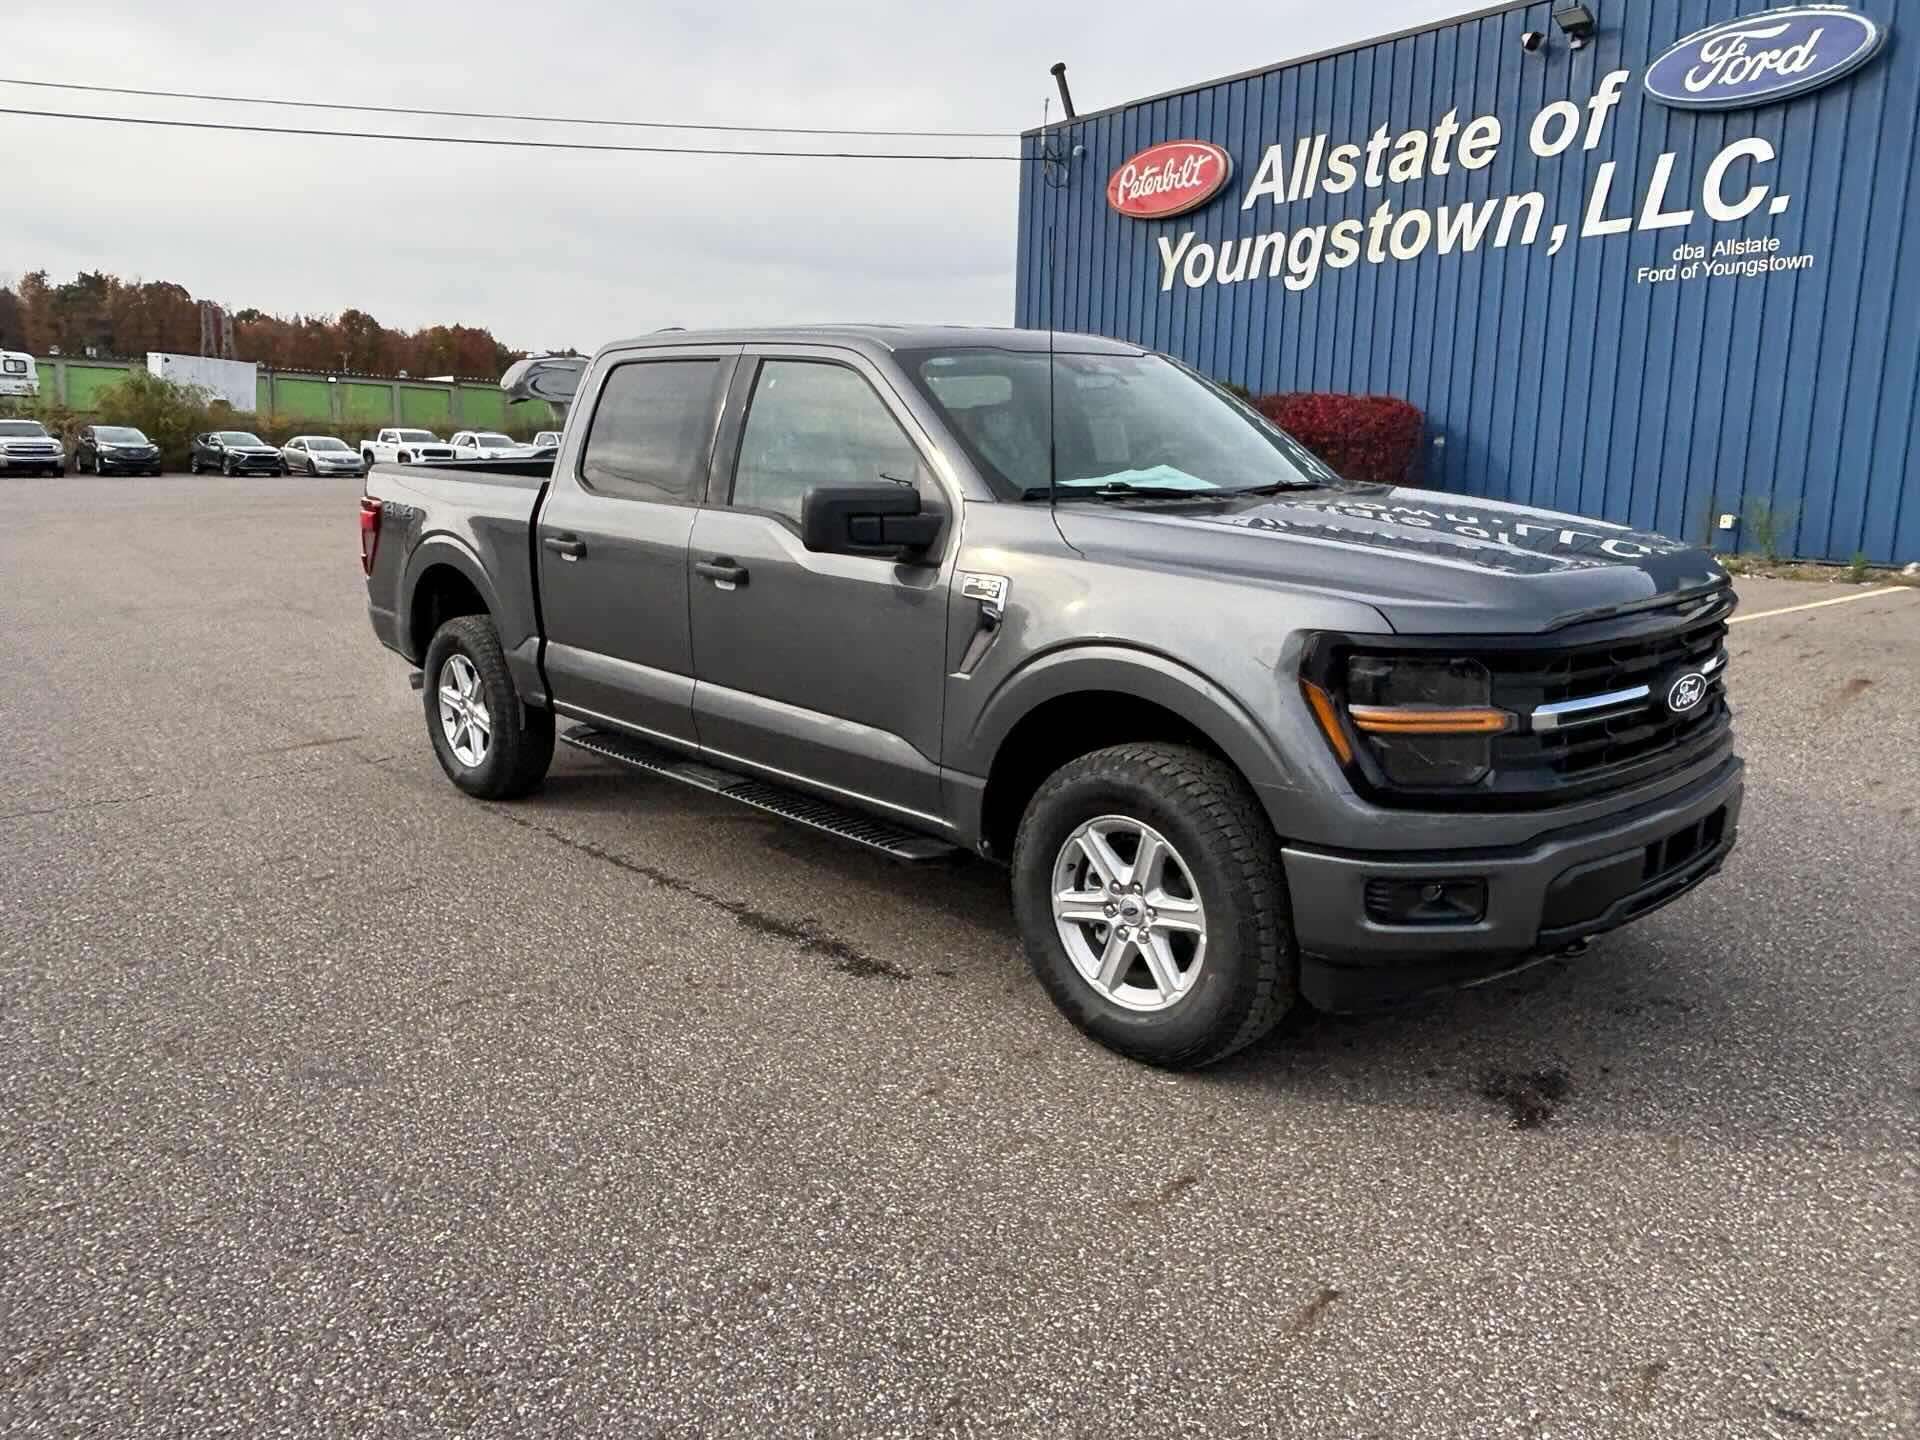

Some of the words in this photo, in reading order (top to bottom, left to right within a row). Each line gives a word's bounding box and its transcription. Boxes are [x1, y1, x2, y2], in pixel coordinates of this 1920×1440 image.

[1685, 23, 1824, 93] Ford
[1241, 106, 1501, 211] Allstate
[1529, 70, 1630, 157] of
[1117, 154, 1213, 205] Peterbilt
[1580, 137, 1791, 238] LLC.
[1637, 265, 1676, 284] Ford
[1681, 262, 1699, 280] of
[1703, 254, 1814, 277] Youngstown
[1672, 244, 1705, 261] dba
[1712, 236, 1781, 257] Allstate
[1675, 679, 1701, 707] Ford
